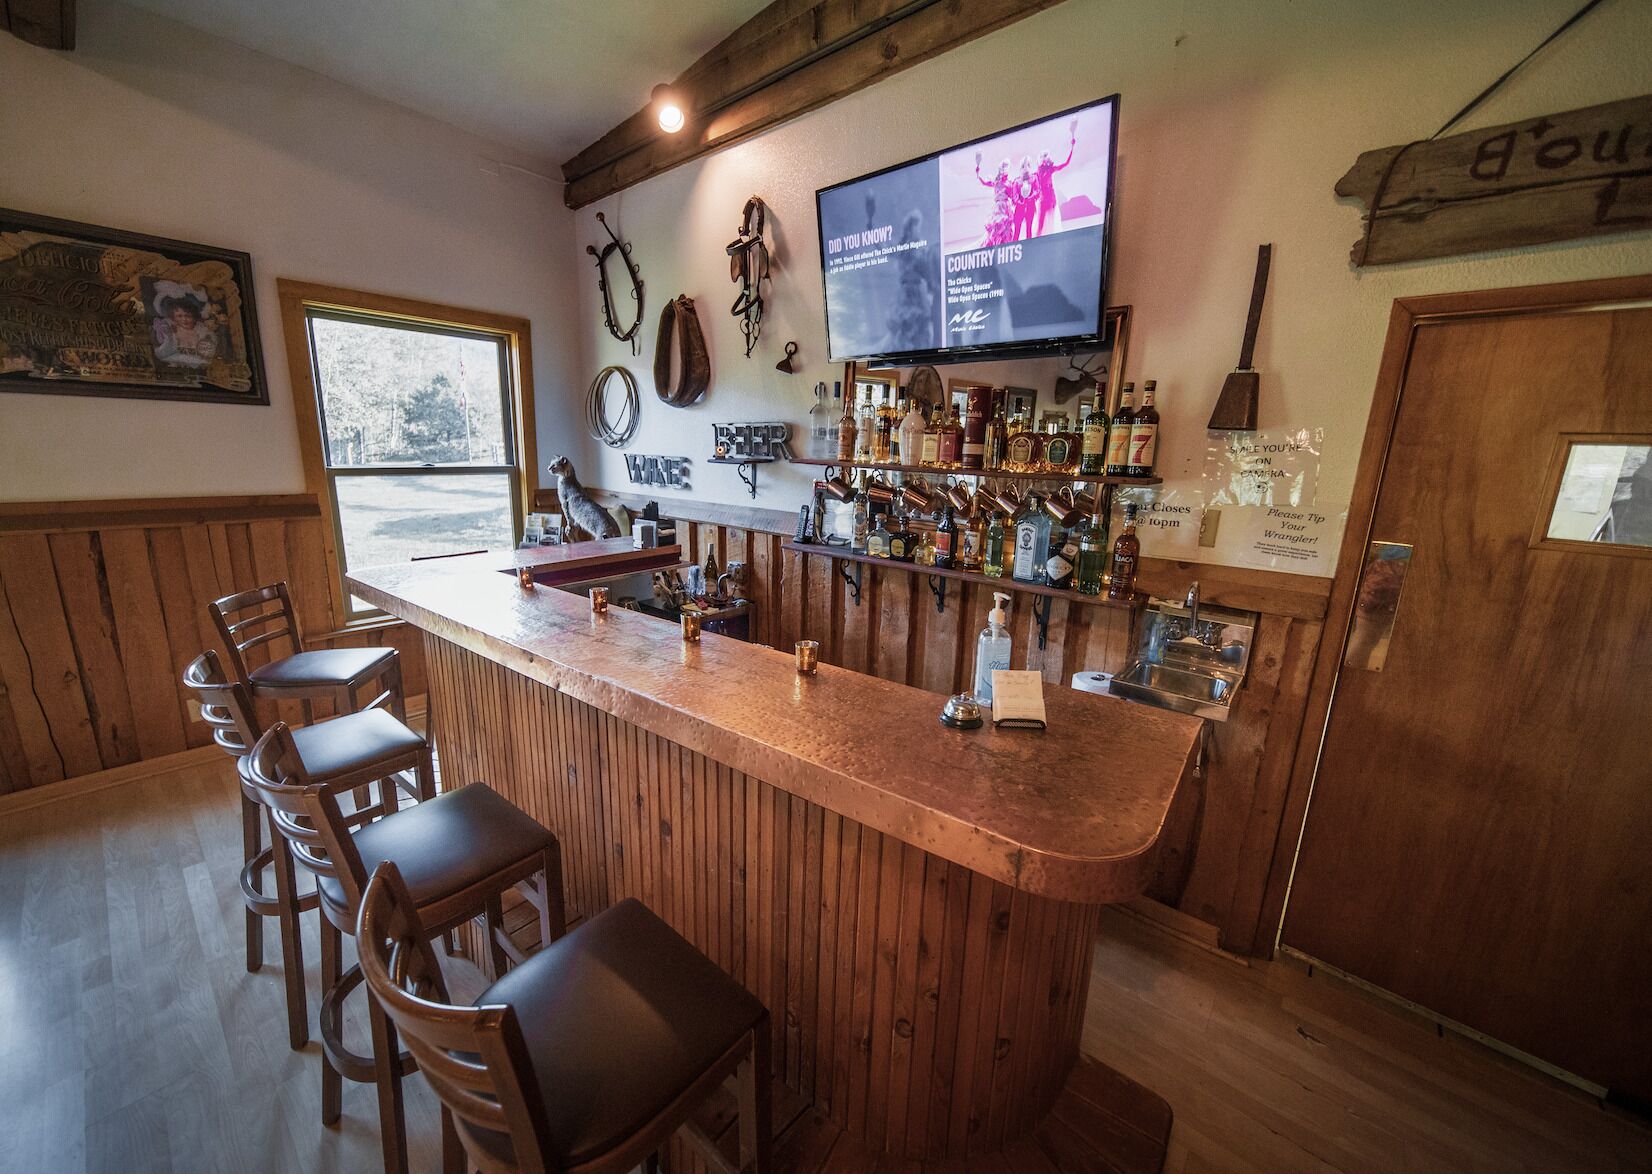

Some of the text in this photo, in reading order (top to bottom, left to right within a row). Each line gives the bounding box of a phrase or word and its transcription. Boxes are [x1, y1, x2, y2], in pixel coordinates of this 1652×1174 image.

[828, 225, 893, 254] DID YOU KNOW?
[948, 244, 1022, 272] COUNTRY HITS
[956, 276, 972, 284] Chicks
[962, 286, 973, 294] Open
[960, 294, 971, 303] Open
[972, 291, 988, 301] Spaces
[712, 422, 792, 460] BEER
[1109, 435, 1130, 464] 7
[1132, 434, 1153, 464] 7
[1262, 444, 1302, 453] YOU'RE
[1256, 457, 1272, 465] ON
[1240, 470, 1285, 478] CAMERA
[1135, 502, 1191, 514] ar Closes
[1136, 516, 1146, 526] @
[1268, 508, 1325, 524] Please Tip
[1281, 521, 1308, 532] Your
[1264, 530, 1318, 544] Wrangler!
